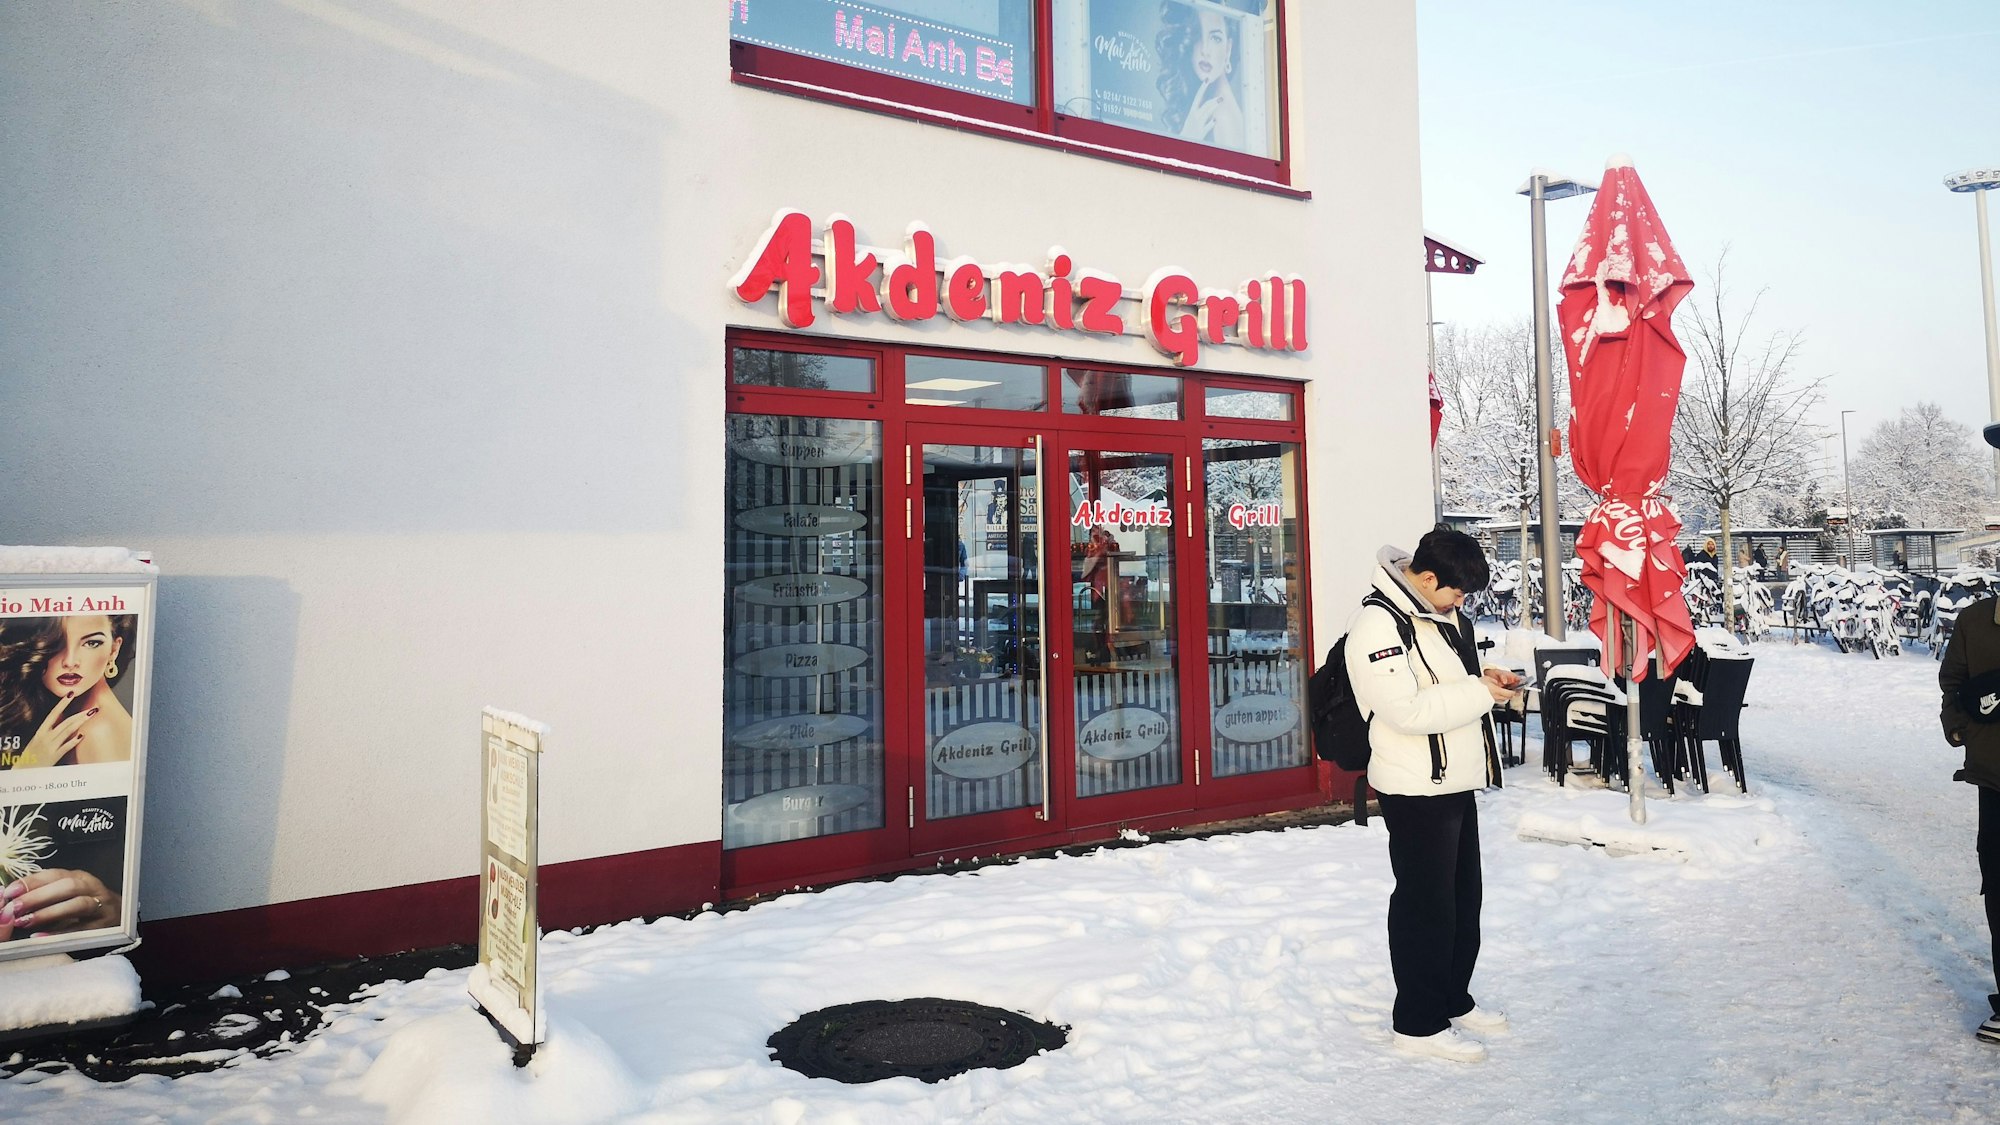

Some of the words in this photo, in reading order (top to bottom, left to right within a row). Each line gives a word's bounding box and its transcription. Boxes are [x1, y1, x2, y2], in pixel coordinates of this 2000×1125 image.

[835, 9, 895, 58] Mai
[902, 28, 966, 76] Anh
[1094, 35, 1124, 61] Mai
[1120, 52, 1151, 72] Anh
[733, 210, 1123, 336] Akdeniz
[1146, 273, 1308, 366] Grill
[781, 441, 825, 460] Suppen
[1073, 501, 1171, 530] Akdeniz
[1228, 503, 1280, 530] Grill
[29, 596, 73, 613] Mai
[79, 595, 126, 612] Anh
[785, 653, 818, 669] Pizza
[1980, 692, 1996, 708] NIKE
[1225, 710, 1253, 729] guten
[1083, 728, 1132, 746] Akdeniz
[1138, 721, 1165, 739] Grill
[937, 744, 994, 763] Akdeniz
[1000, 737, 1032, 755] Grill
[13, 784, 36, 793] 10.00
[45, 782, 68, 790] 18.00
[71, 779, 87, 788] Uhr
[782, 795, 824, 811] Burgr
[58, 814, 87, 832] Mai
[82, 816, 114, 833] Anh
